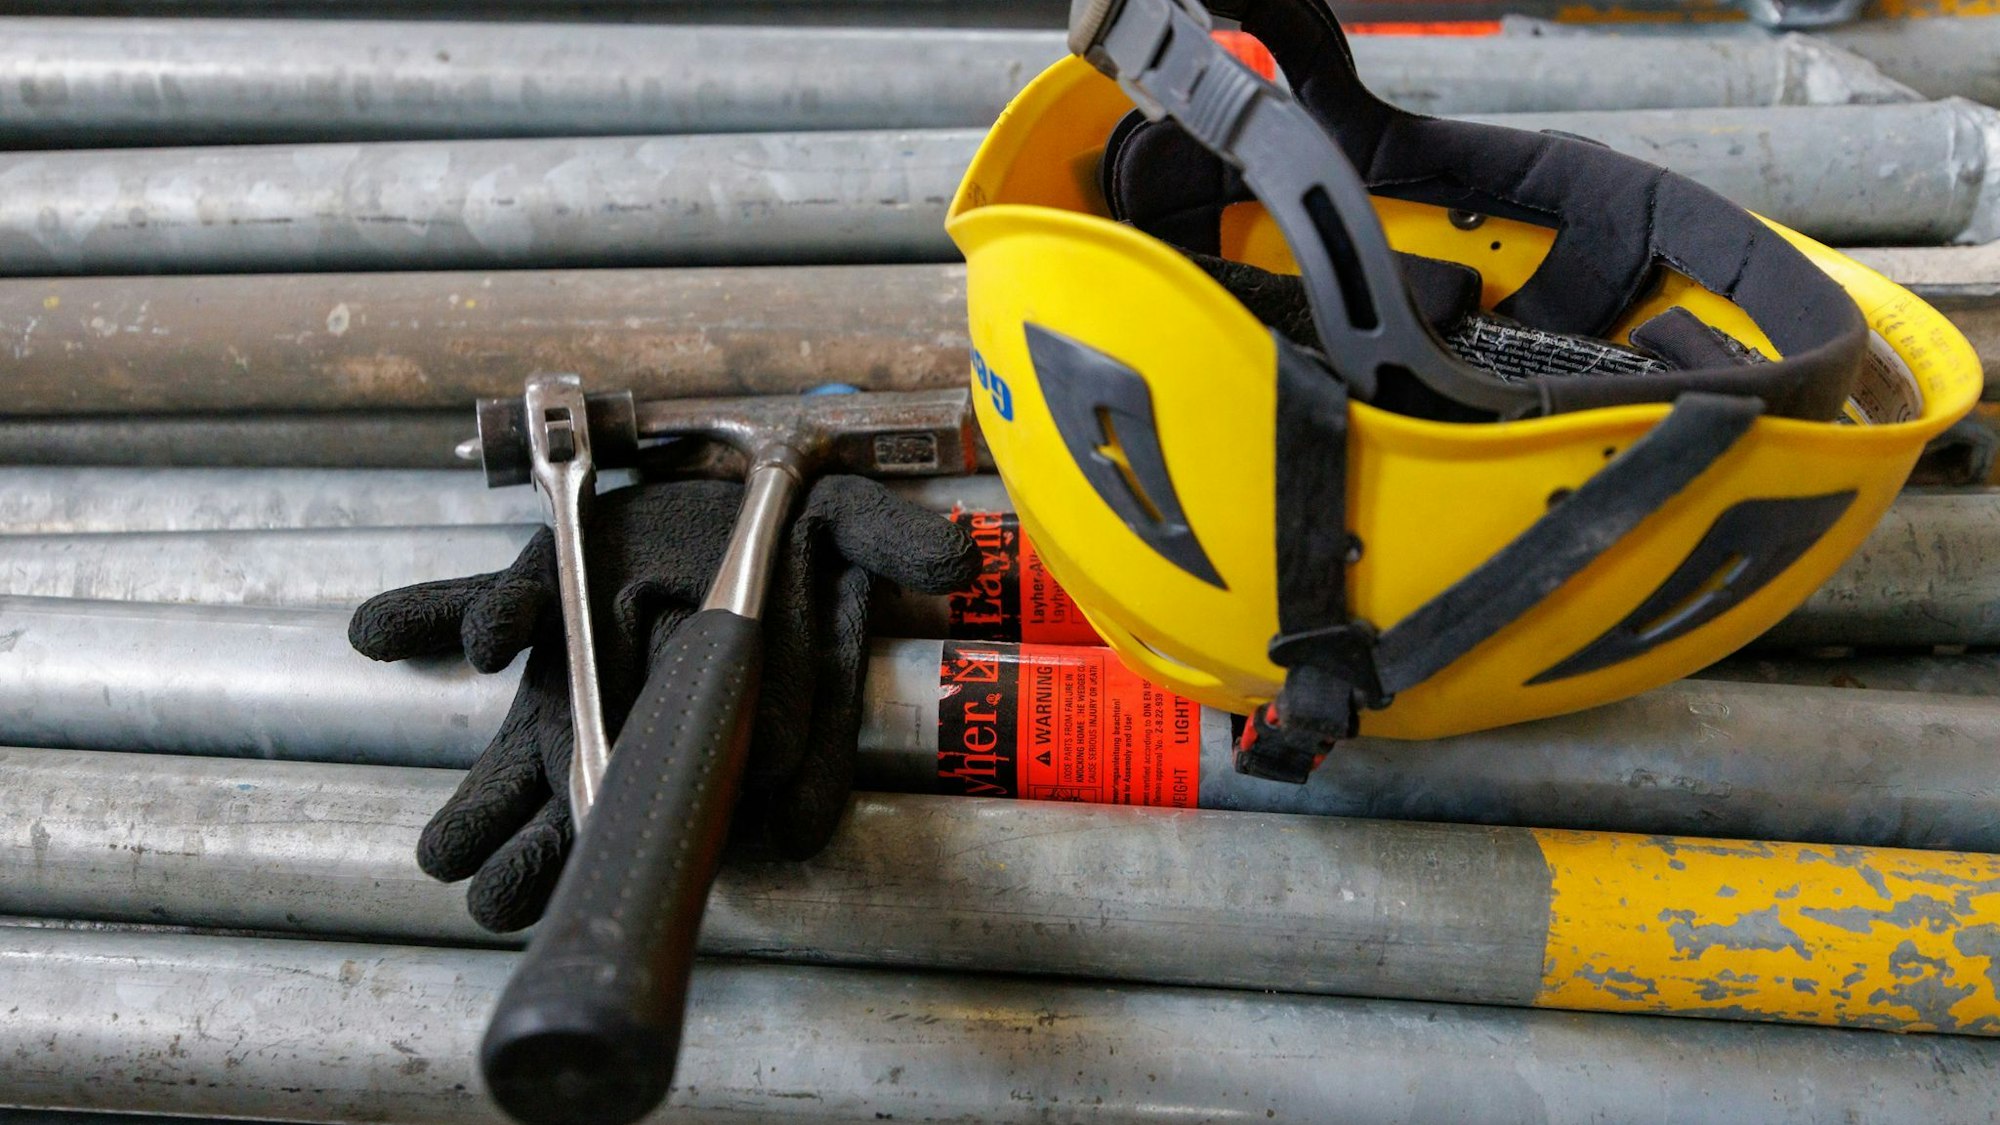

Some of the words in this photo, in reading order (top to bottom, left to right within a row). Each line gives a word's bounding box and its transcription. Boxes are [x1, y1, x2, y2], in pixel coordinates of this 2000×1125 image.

[1066, 673, 1074, 681] IN
[1078, 673, 1087, 702] WEDGES
[1090, 687, 1098, 697] OR
[1145, 691, 1152, 701] EN
[1035, 666, 1052, 745] WARNING
[1078, 703, 1086, 719] HE
[1090, 699, 1098, 727] INJURY
[1112, 698, 1121, 735] beachten!
[1156, 693, 1164, 734] Z-8.22-939
[1065, 714, 1073, 736] FROM
[1124, 714, 1132, 731] Use!
[1145, 719, 1152, 727] to
[1174, 695, 1189, 744] LIGHT
[1078, 721, 1086, 744] HOME
[1124, 734, 1132, 748] and
[1065, 738, 1073, 761] PARTS
[1089, 729, 1098, 761] SERIOUS
[1145, 729, 1153, 764] according
[1064, 763, 1073, 783] LOOSE
[1077, 746, 1086, 783] KNOCKING
[1089, 761, 1098, 784] CAUSE
[1124, 749, 1133, 783] Assembly
[1155, 753, 1164, 781] approval
